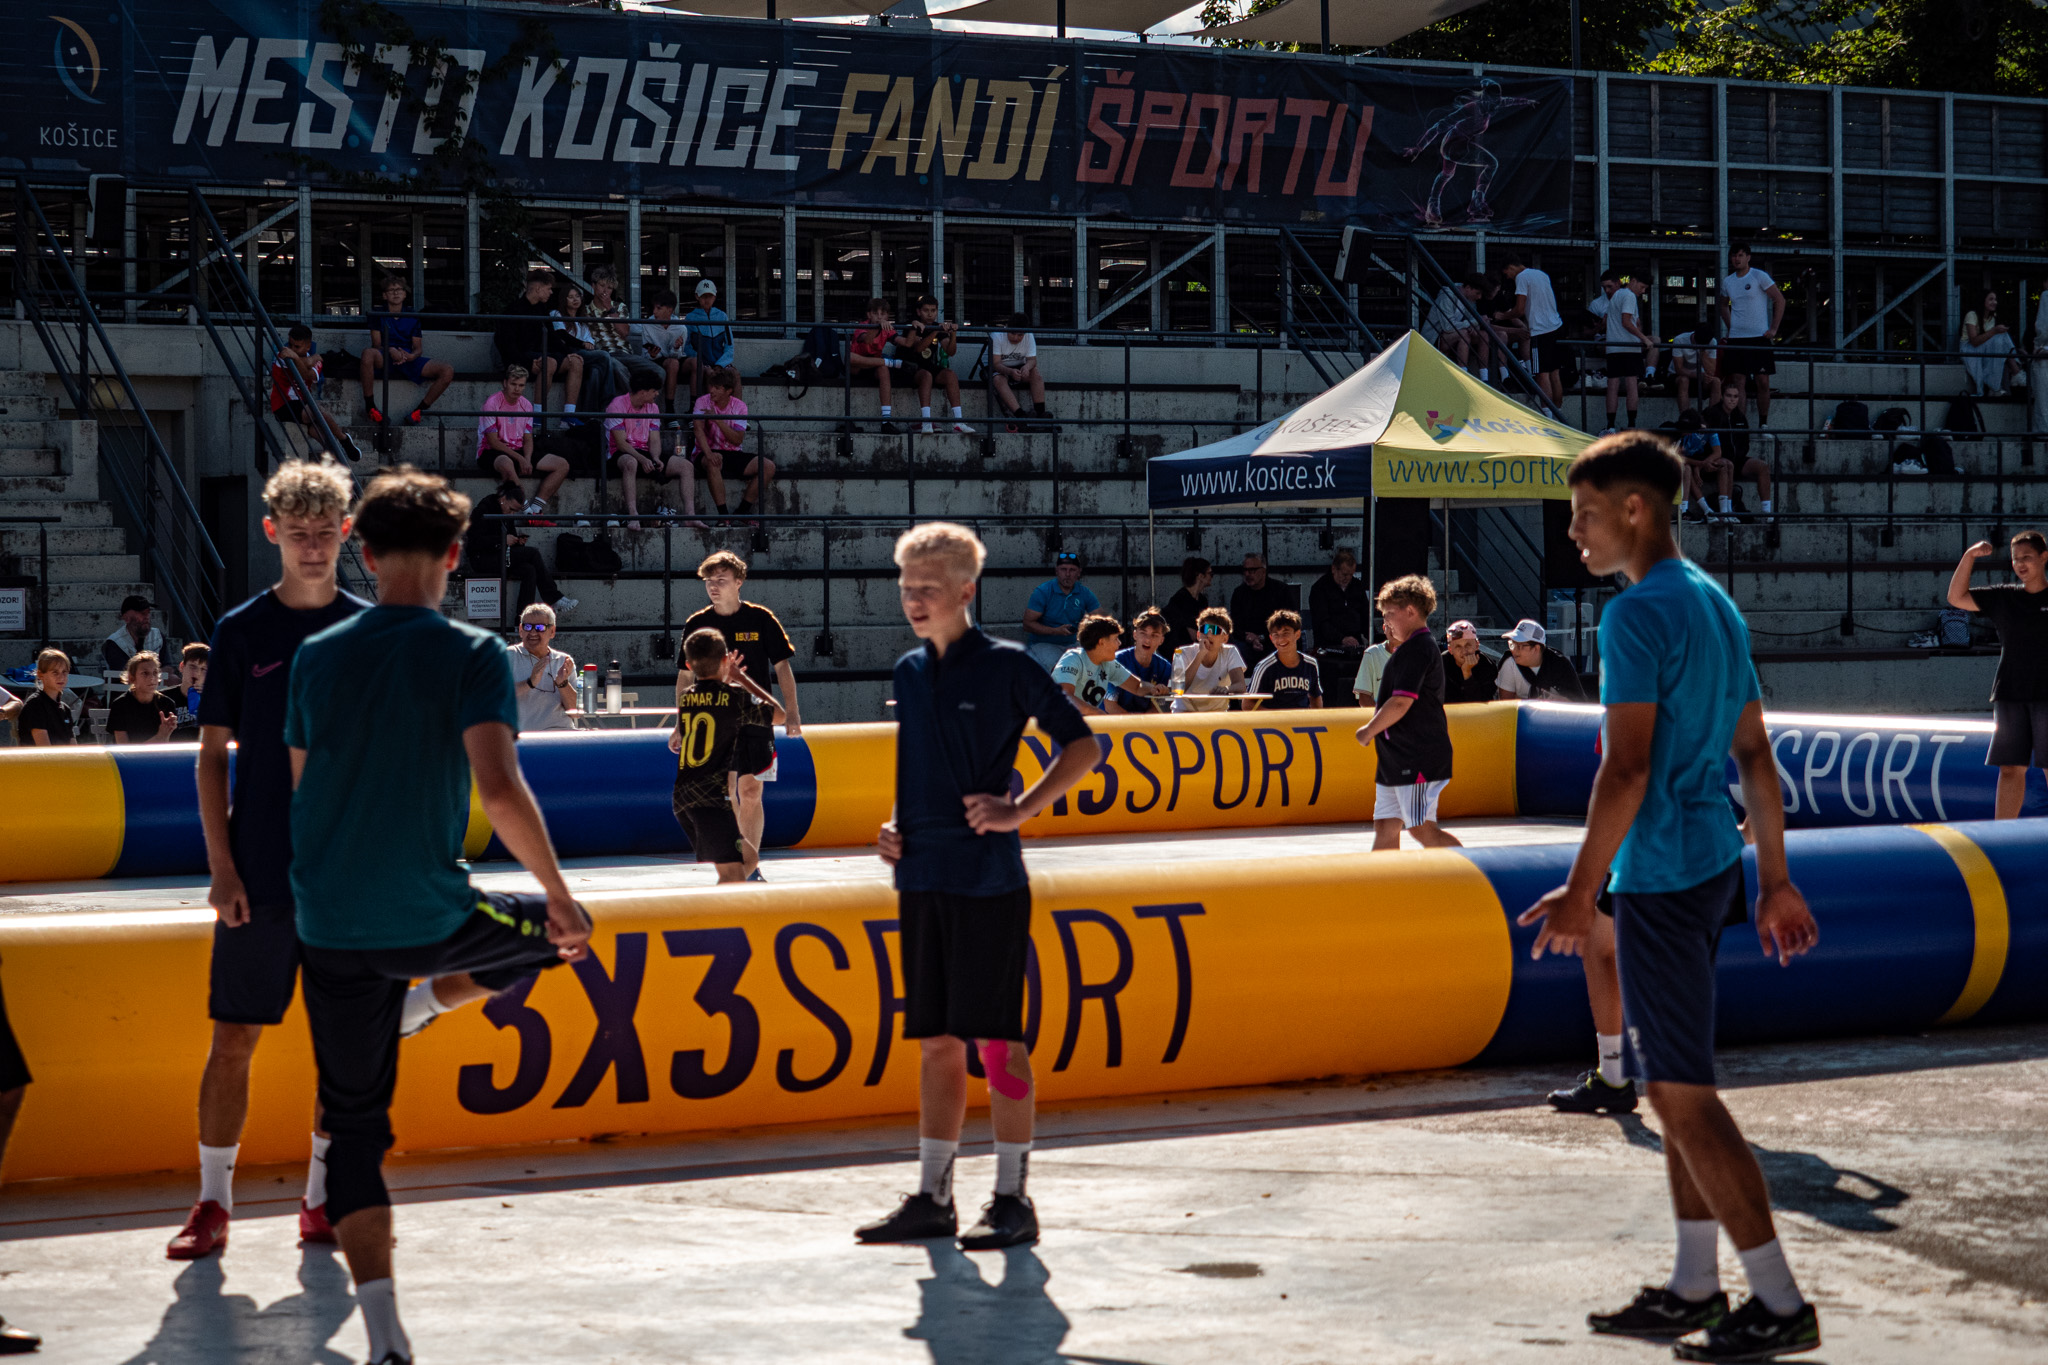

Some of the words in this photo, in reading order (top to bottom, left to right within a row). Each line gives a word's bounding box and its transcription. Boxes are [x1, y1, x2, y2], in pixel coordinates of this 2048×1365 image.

[40, 122, 118, 148] KOŠICE
[173, 35, 486, 155] MESTO
[500, 42, 818, 171] KOŠICE
[827, 65, 1067, 182] FANDÍ
[1076, 70, 1375, 197] ŠPORTU
[1463, 417, 1564, 439] Košice
[1181, 457, 1336, 497] www.kosice.sk
[1388, 456, 1574, 490] www.sportk
[679, 692, 713, 707] EYMAR
[715, 690, 730, 706] JR
[1273, 676, 1310, 692] ADIDAS
[679, 712, 716, 769] 10
[1010, 726, 1328, 817] X3SPORT
[1729, 729, 1966, 821] SPORT
[457, 902, 1206, 1115] 3X3SPRT
